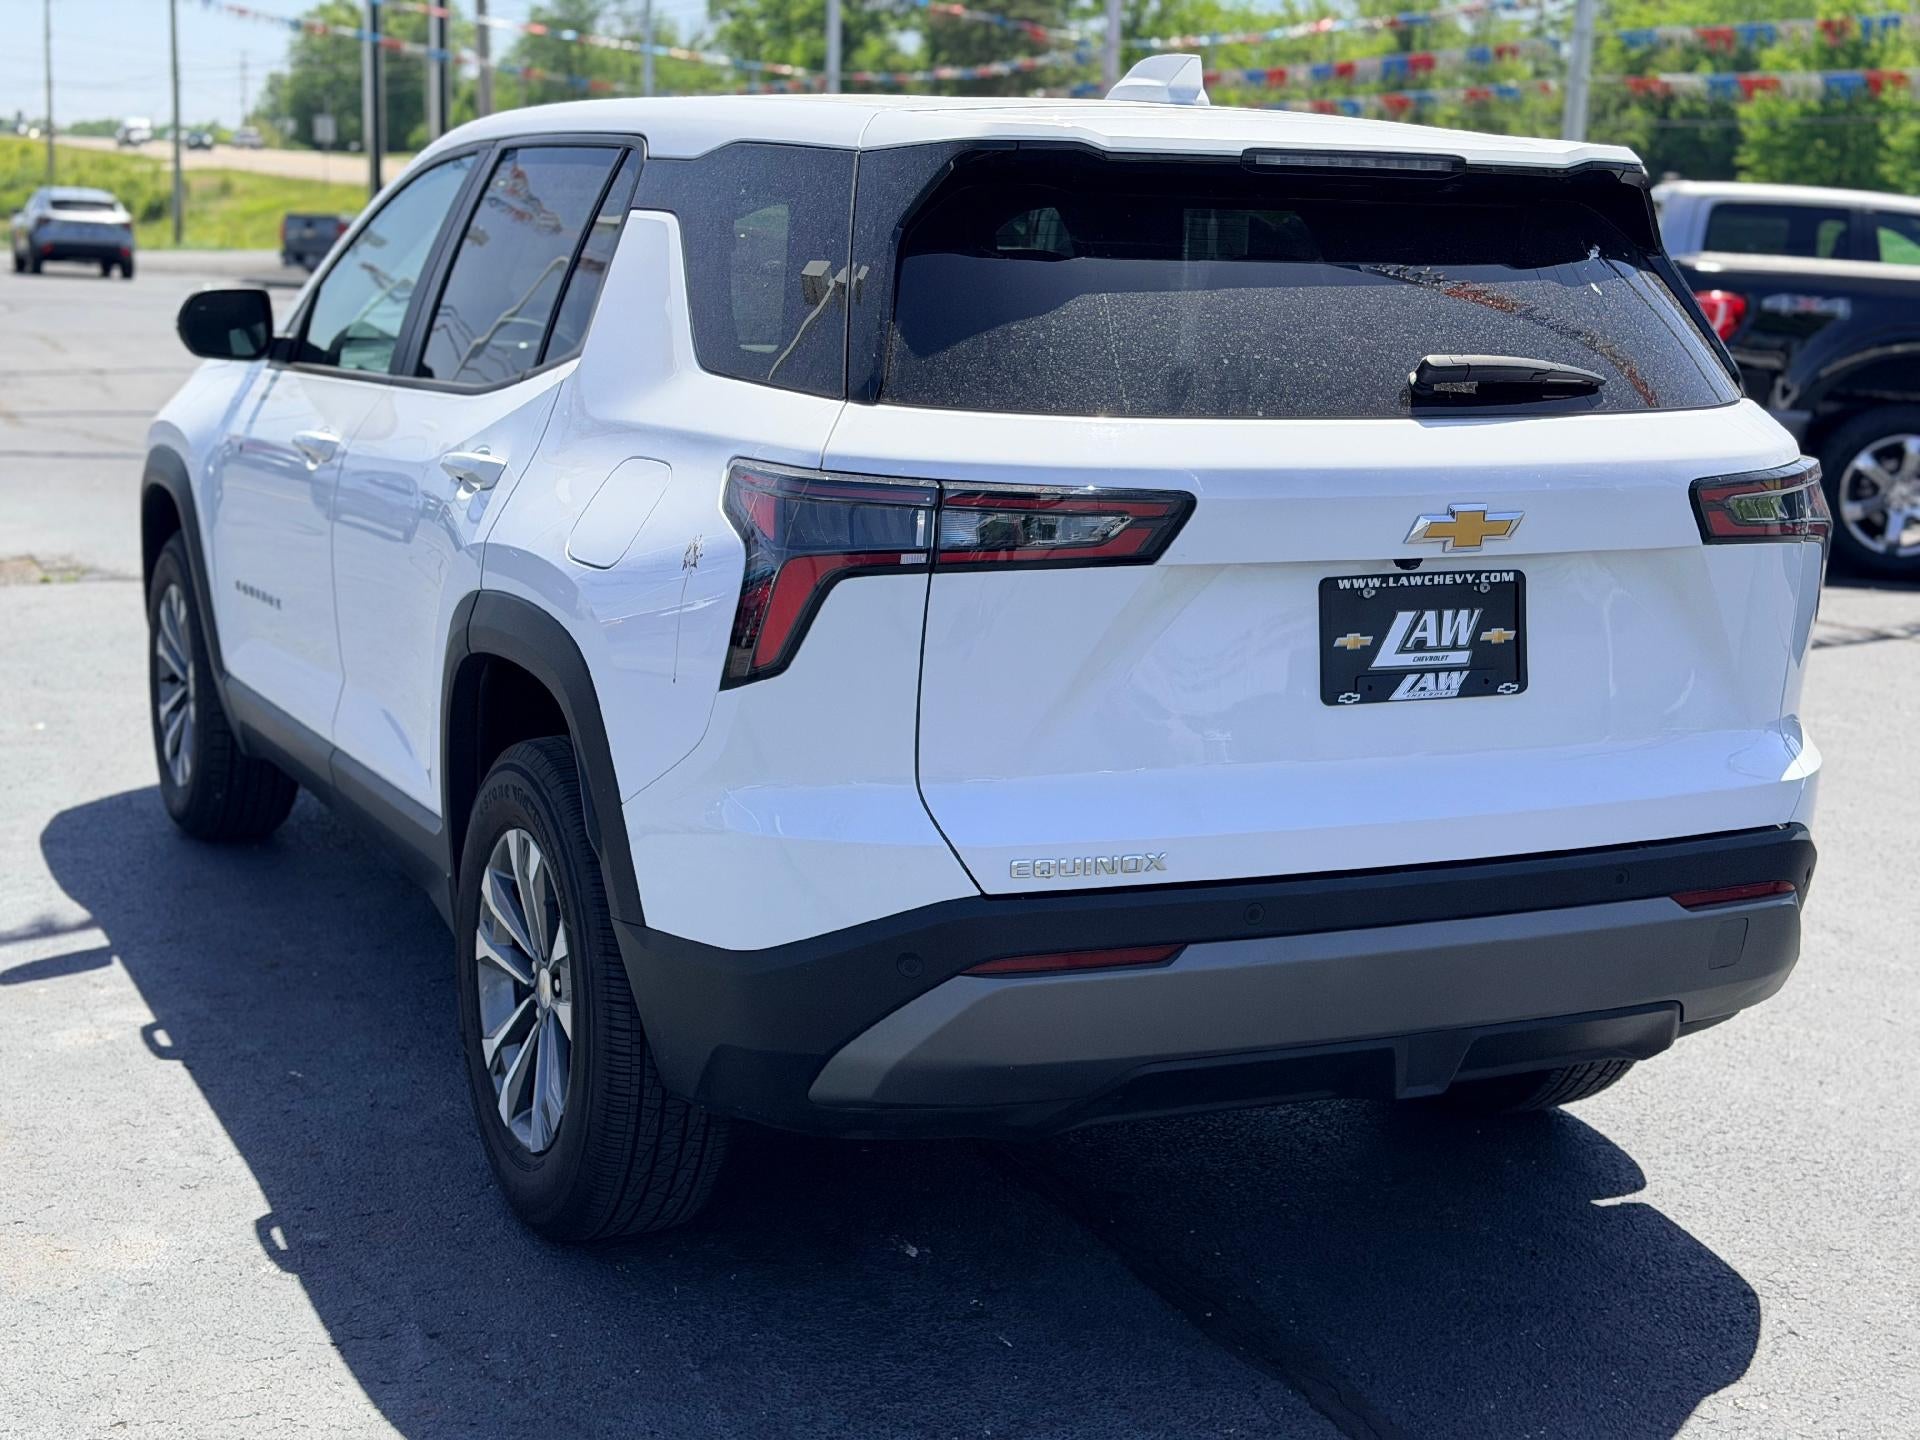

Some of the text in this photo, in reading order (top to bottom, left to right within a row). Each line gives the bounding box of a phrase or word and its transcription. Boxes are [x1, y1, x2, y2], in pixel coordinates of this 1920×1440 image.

[1337, 571, 1515, 589] WWW.LAWCHEVY.COM
[1369, 608, 1482, 669] LAW
[1412, 654, 1450, 663] CHEVROLET
[1388, 670, 1470, 700] LAW
[1010, 852, 1167, 878] EQUINOX
